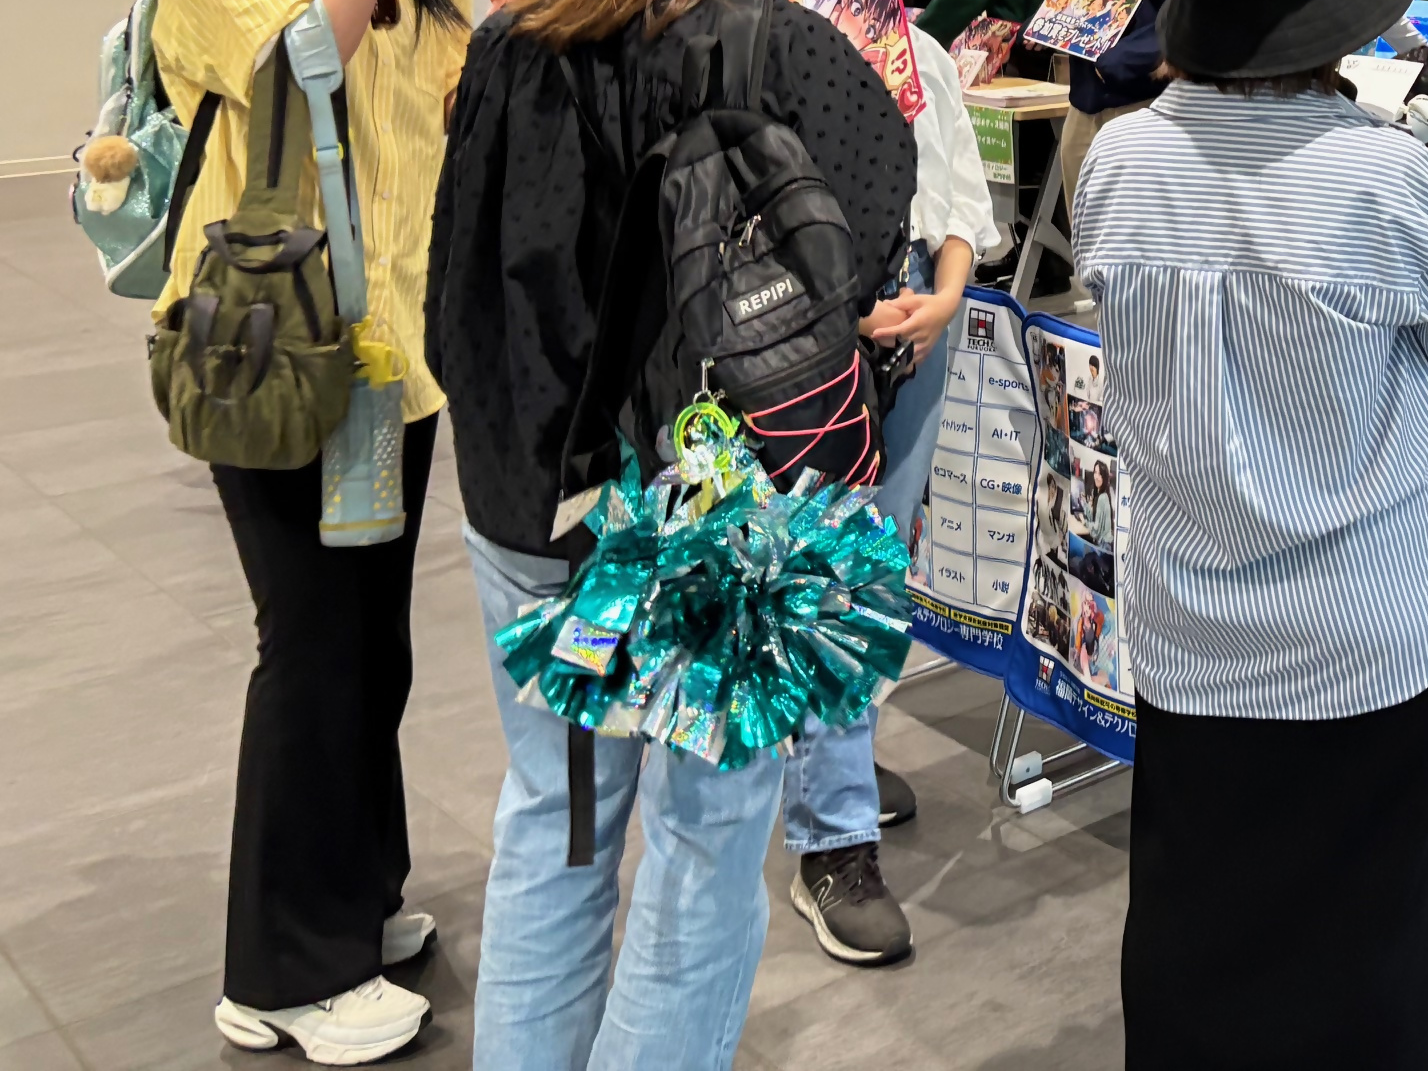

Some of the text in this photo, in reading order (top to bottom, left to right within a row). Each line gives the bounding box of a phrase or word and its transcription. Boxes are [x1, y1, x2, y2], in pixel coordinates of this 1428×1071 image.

[739, 278, 793, 315] REPIPI
[948, 367, 966, 381] ーム
[934, 465, 968, 485] eコマース
[980, 478, 1022, 495] CG・映像
[940, 516, 962, 531] アニメ
[987, 529, 1015, 543] マンガ
[938, 566, 966, 584] イラスト
[992, 580, 1010, 594] 小説
